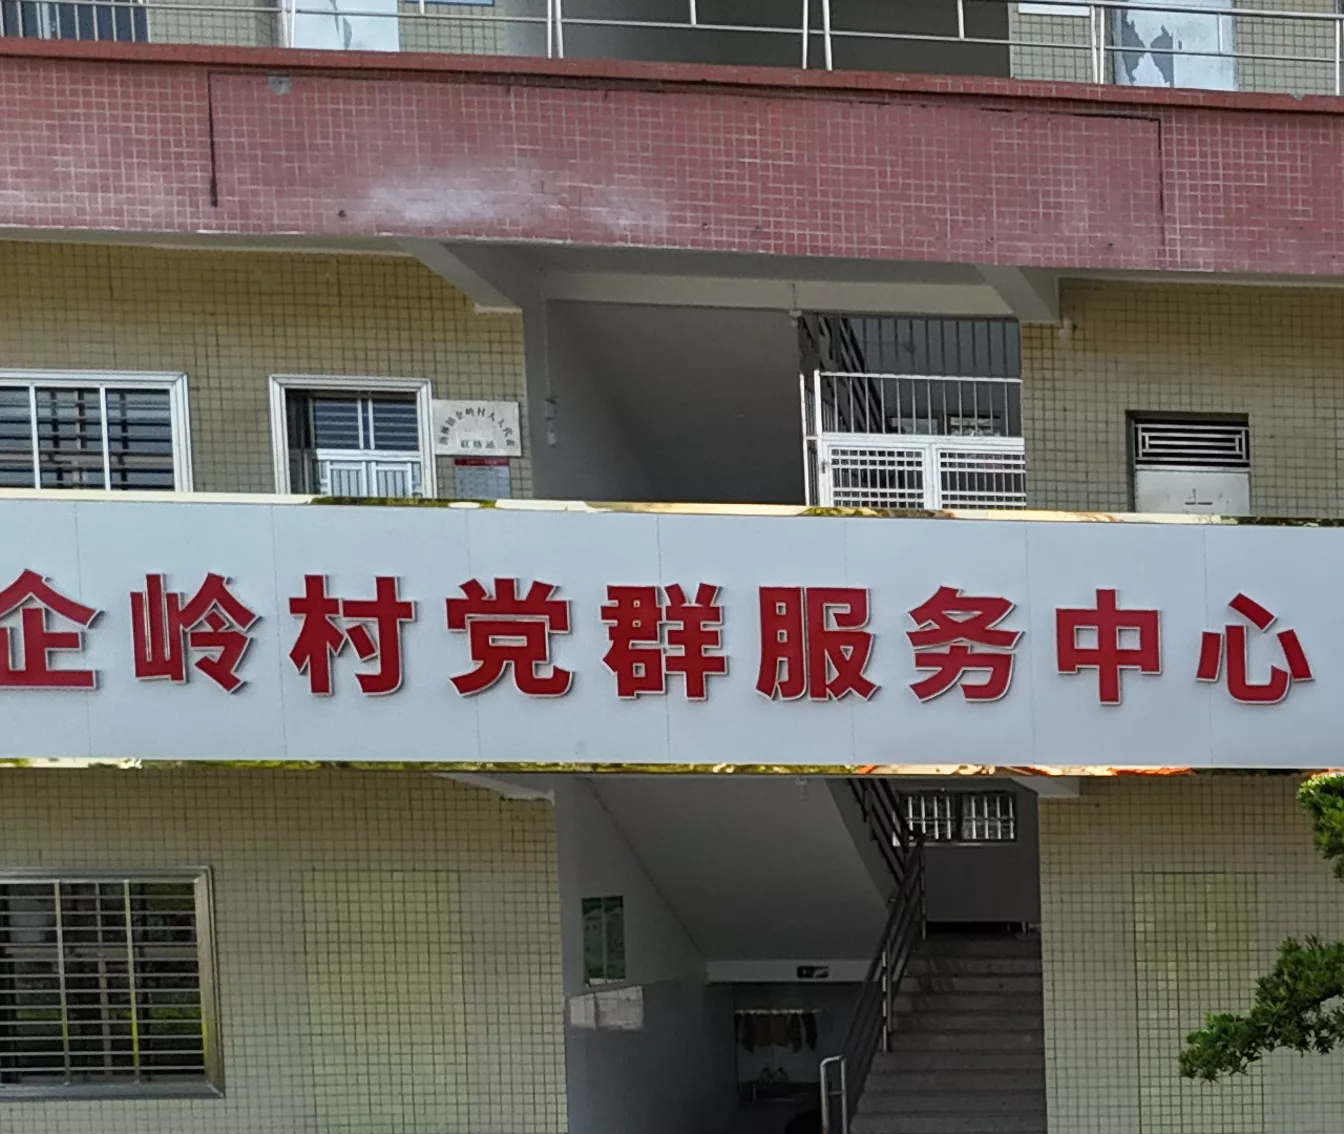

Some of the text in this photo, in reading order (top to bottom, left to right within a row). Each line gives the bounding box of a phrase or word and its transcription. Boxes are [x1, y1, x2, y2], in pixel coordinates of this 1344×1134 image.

[0, 568, 1313, 705] 企岭村党群服务中心
